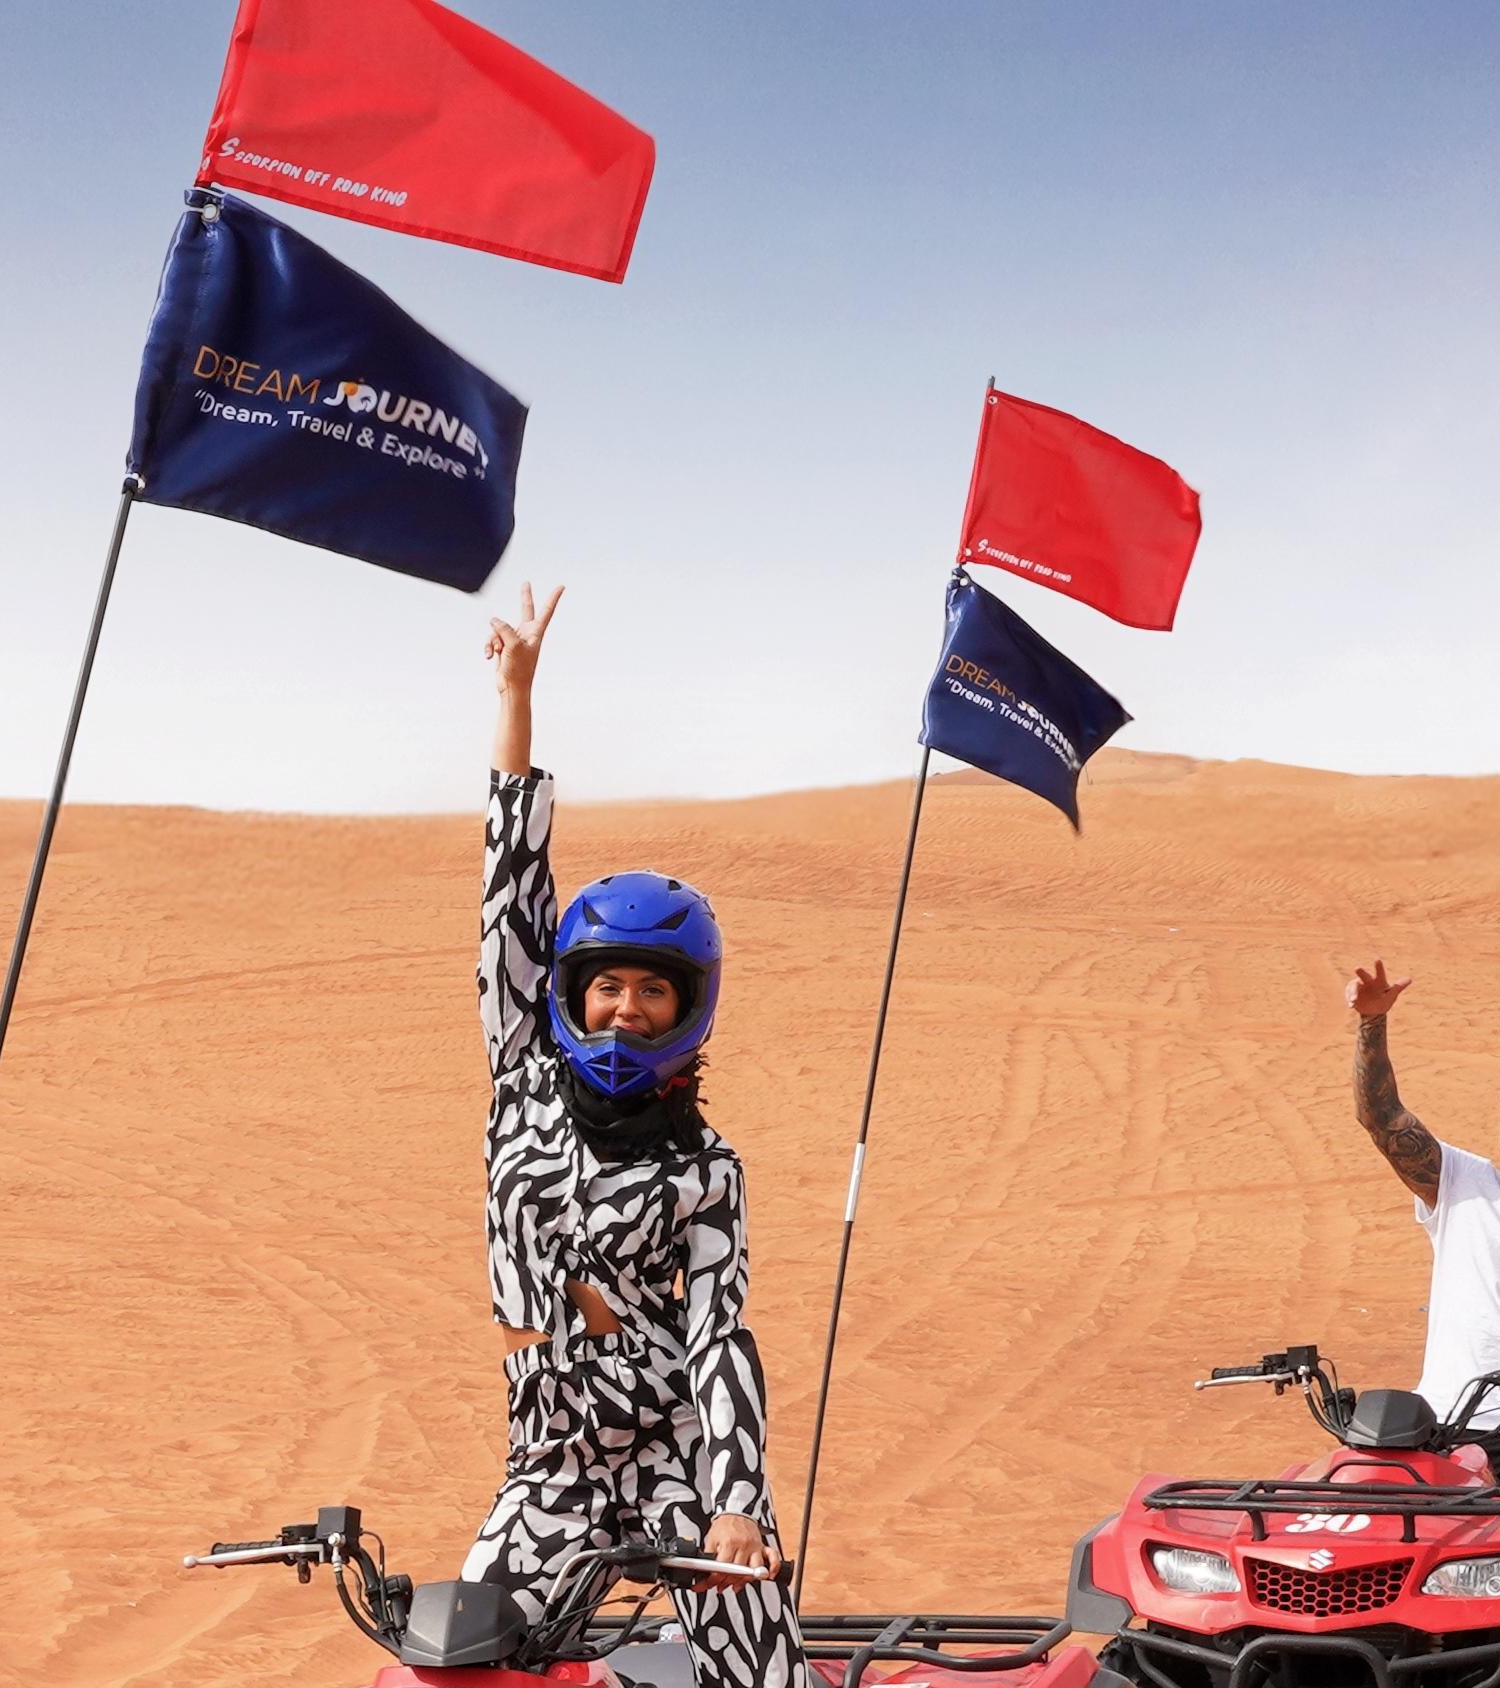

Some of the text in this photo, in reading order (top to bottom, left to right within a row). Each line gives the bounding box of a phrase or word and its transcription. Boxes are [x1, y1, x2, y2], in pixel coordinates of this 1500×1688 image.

[304, 169, 331, 187] OFF
[332, 177, 369, 197] ROAD
[370, 186, 408, 207] KING
[193, 345, 321, 405] DREAM
[287, 410, 353, 443] Travel
[356, 427, 375, 450] &
[381, 432, 468, 480] Explore
[945, 654, 1082, 771] DREAM JOURNE
[999, 702, 1034, 731] Travel
[1284, 1513, 1371, 1534] 30
